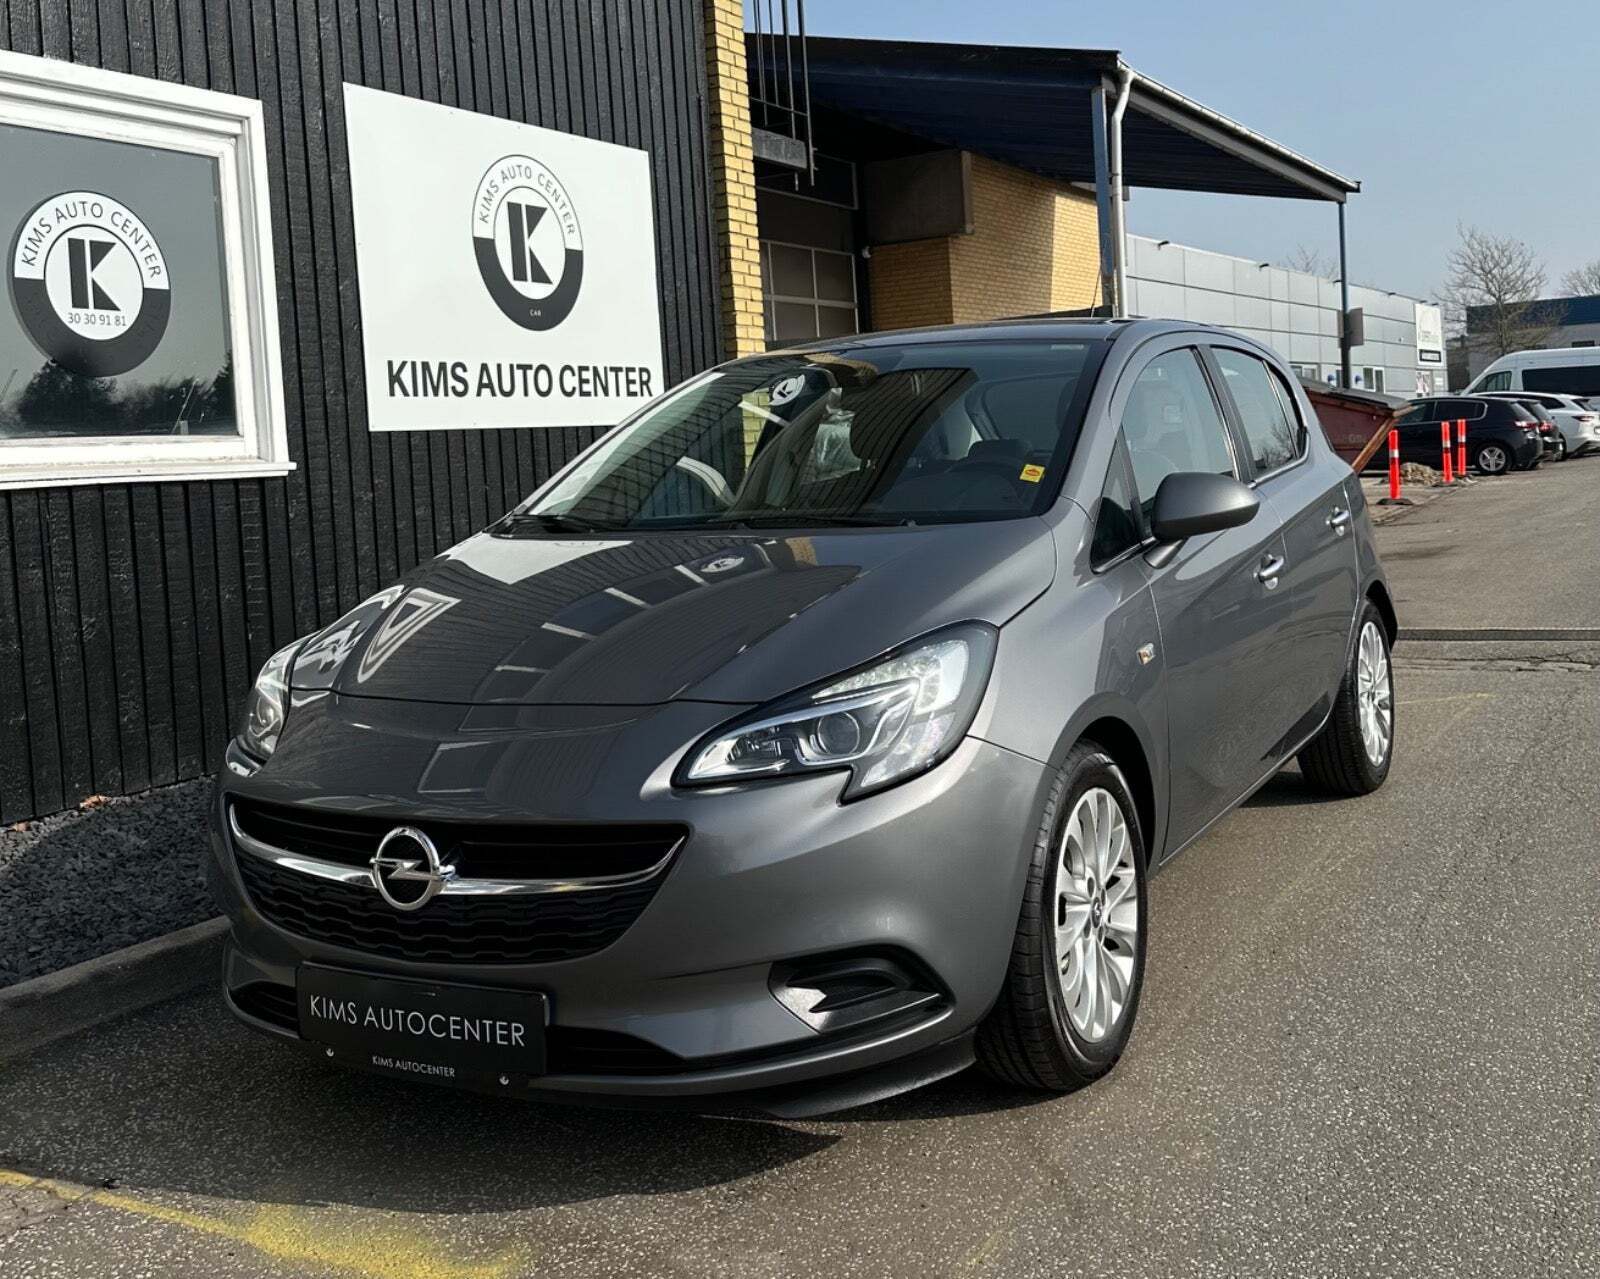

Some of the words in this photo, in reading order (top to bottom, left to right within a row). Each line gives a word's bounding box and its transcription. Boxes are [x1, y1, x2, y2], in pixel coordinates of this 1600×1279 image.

[479, 180, 499, 223] KIMS
[501, 164, 532, 184] AUTO
[537, 173, 576, 235] CENTER
[21, 217, 52, 266] KIMS
[55, 201, 104, 224] AUTO
[110, 211, 162, 278] CENTER
[507, 201, 553, 284] K
[67, 237, 121, 312] K
[67, 312, 81, 324] 30
[84, 313, 97, 325] 30
[98, 314, 111, 326] 91
[114, 315, 126, 327] 81
[387, 360, 469, 398] KIMS
[476, 362, 553, 398] AUTO
[559, 364, 653, 398] CENTER
[310, 994, 357, 1025] KIMS
[364, 1006, 525, 1047] AUTOCENTER
[372, 1055, 393, 1069] KIMS
[395, 1060, 455, 1078] AUTOCENTER
